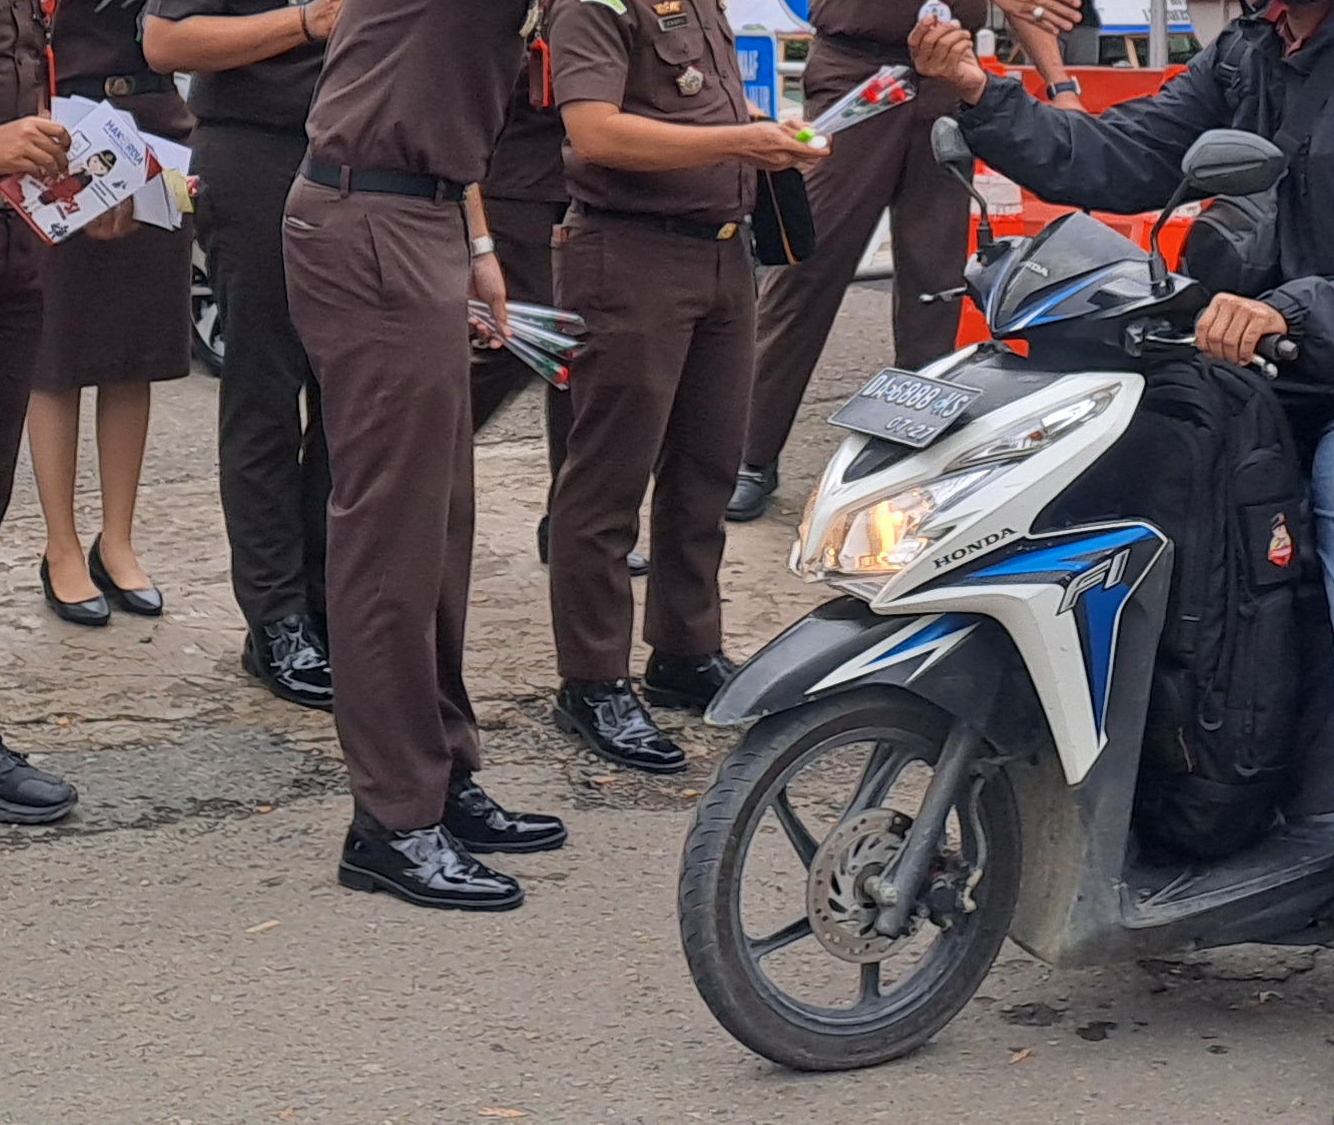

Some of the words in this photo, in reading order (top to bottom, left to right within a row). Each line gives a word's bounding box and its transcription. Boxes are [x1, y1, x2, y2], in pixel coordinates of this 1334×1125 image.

[861, 375, 897, 399] DA
[886, 380, 942, 410] 6888
[932, 527, 1019, 571] HONDA
[1056, 547, 1132, 617] FI
